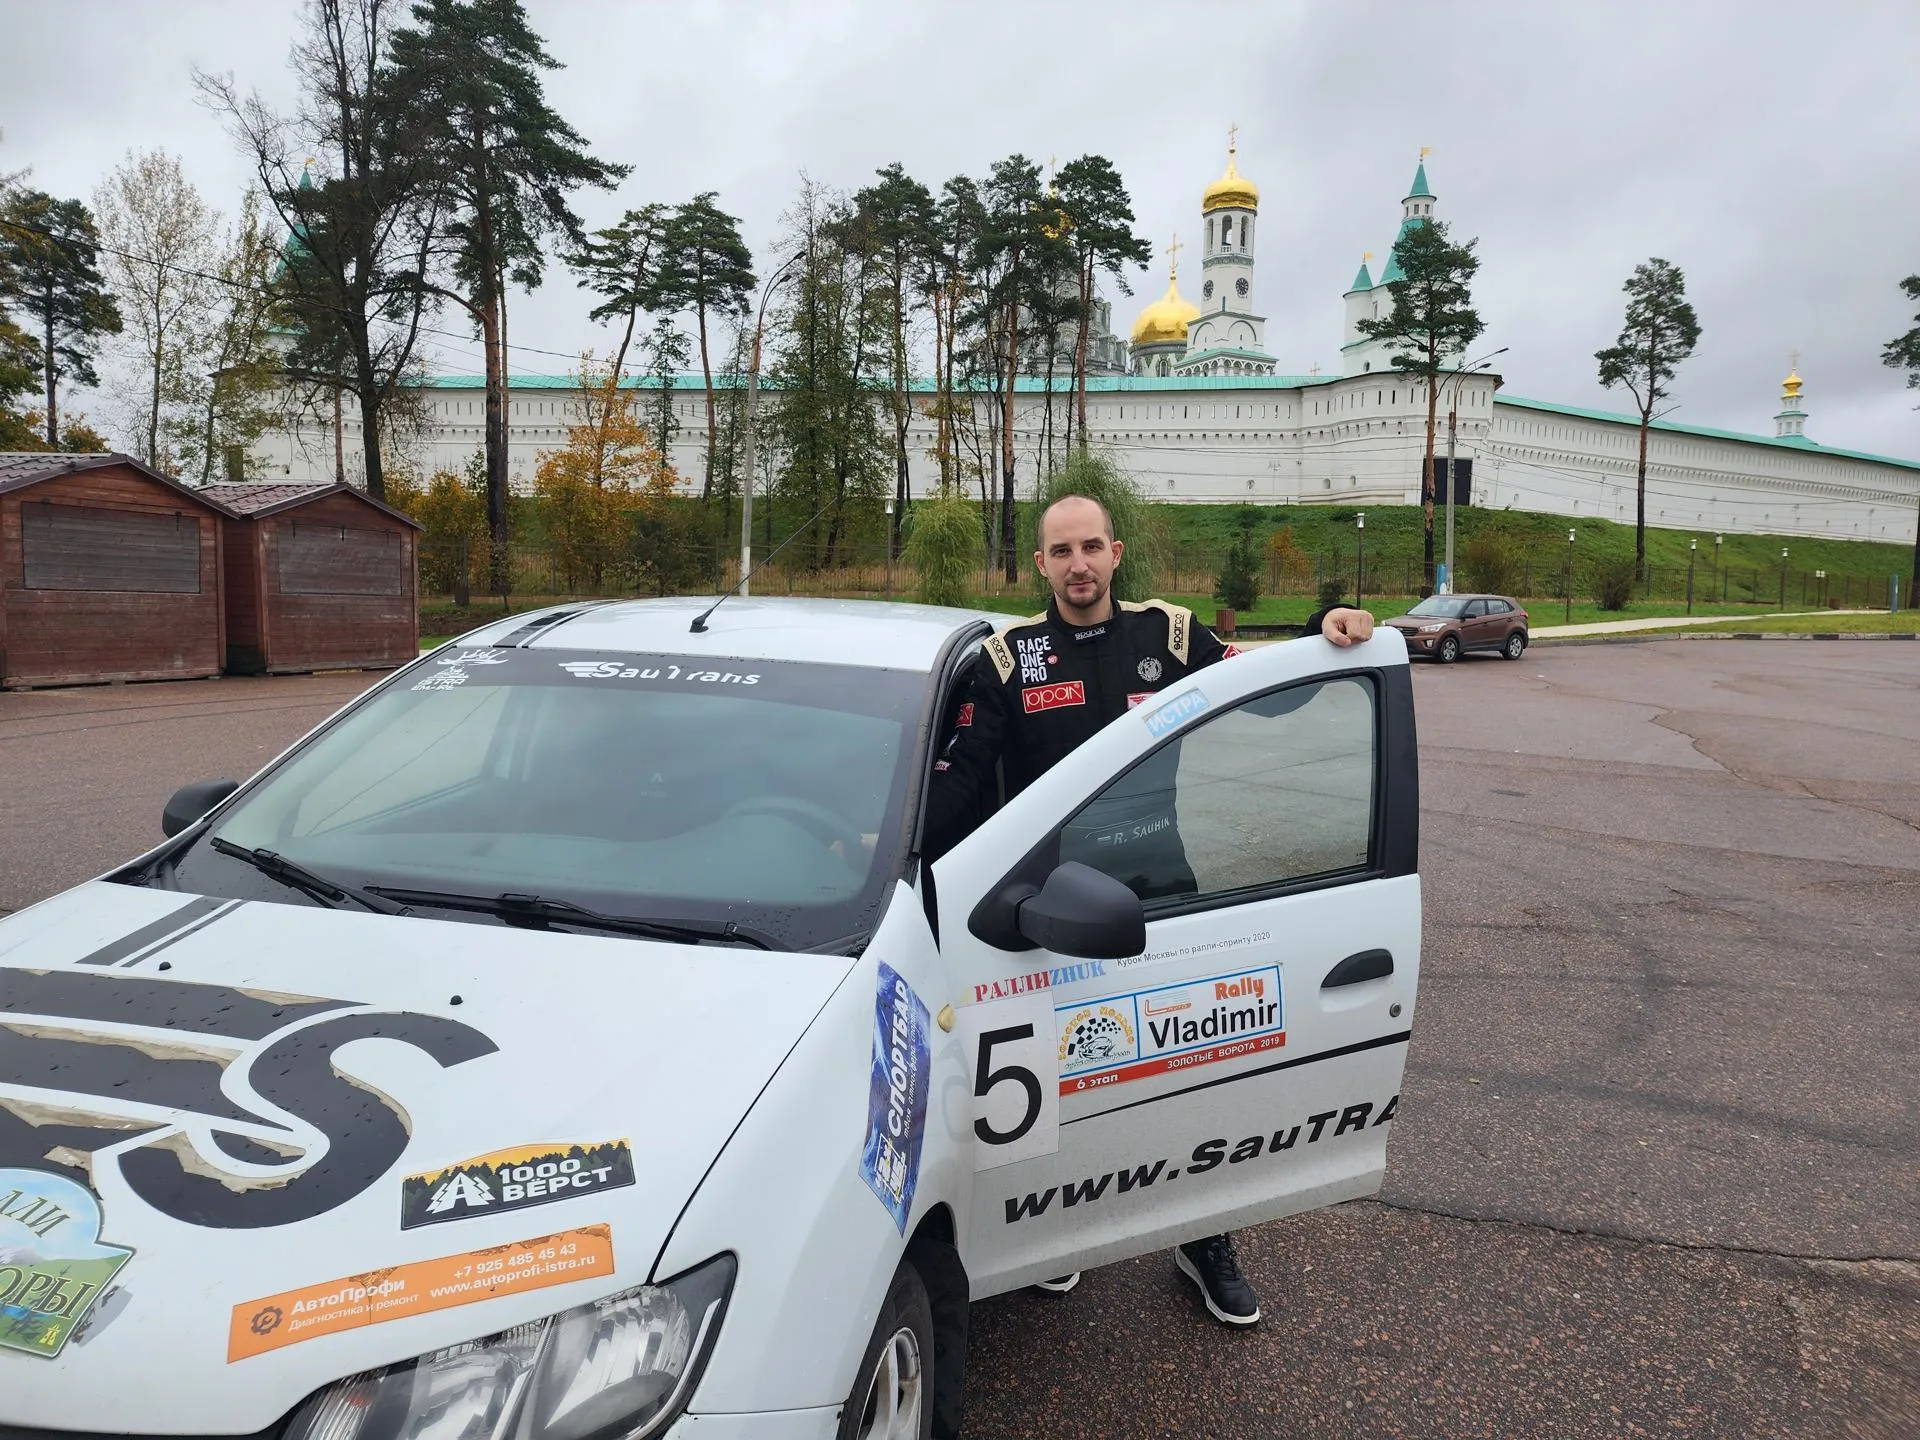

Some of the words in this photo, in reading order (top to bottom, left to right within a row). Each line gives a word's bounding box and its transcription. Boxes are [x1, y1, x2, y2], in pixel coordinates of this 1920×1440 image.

[1016, 636, 1051, 653] RACE
[1020, 652, 1046, 668] ONE
[1021, 666, 1048, 683] PRO
[1148, 695, 1204, 731] ИСТРА
[1113, 832, 1128, 845] R.
[1117, 954, 1142, 967] Кубок
[1144, 950, 1178, 962] Москвы
[1180, 946, 1190, 954] по
[1191, 935, 1251, 954] ралли-спринту
[1253, 931, 1271, 943] 2020
[1214, 976, 1265, 1000] Rally
[1148, 998, 1278, 1049] Vladimir
[887, 978, 909, 1138] СПОРТБАР
[1167, 1051, 1214, 1069] ЗОЛОТЫЕ
[1219, 1044, 1256, 1057] ВОРОТА
[1260, 1036, 1280, 1049] 2019
[973, 1022, 1043, 1146] 5
[1076, 1079, 1086, 1090] 6
[1089, 1074, 1119, 1088] этап
[500, 1158, 581, 1185] 1000
[503, 1166, 613, 1203] ВЁРСТ
[430, 1255, 595, 1298] www.autoprofi-istra.ru
[454, 1265, 472, 1279] +7
[476, 1259, 504, 1275] 925
[508, 1252, 534, 1267] 485
[538, 1247, 556, 1261] 45
[559, 1242, 577, 1256] 43
[287, 1306, 363, 1332] Диагностика
[365, 1303, 375, 1313] и
[376, 1294, 419, 1313] ремонт
[291, 1279, 405, 1315] АвтоПрофи
